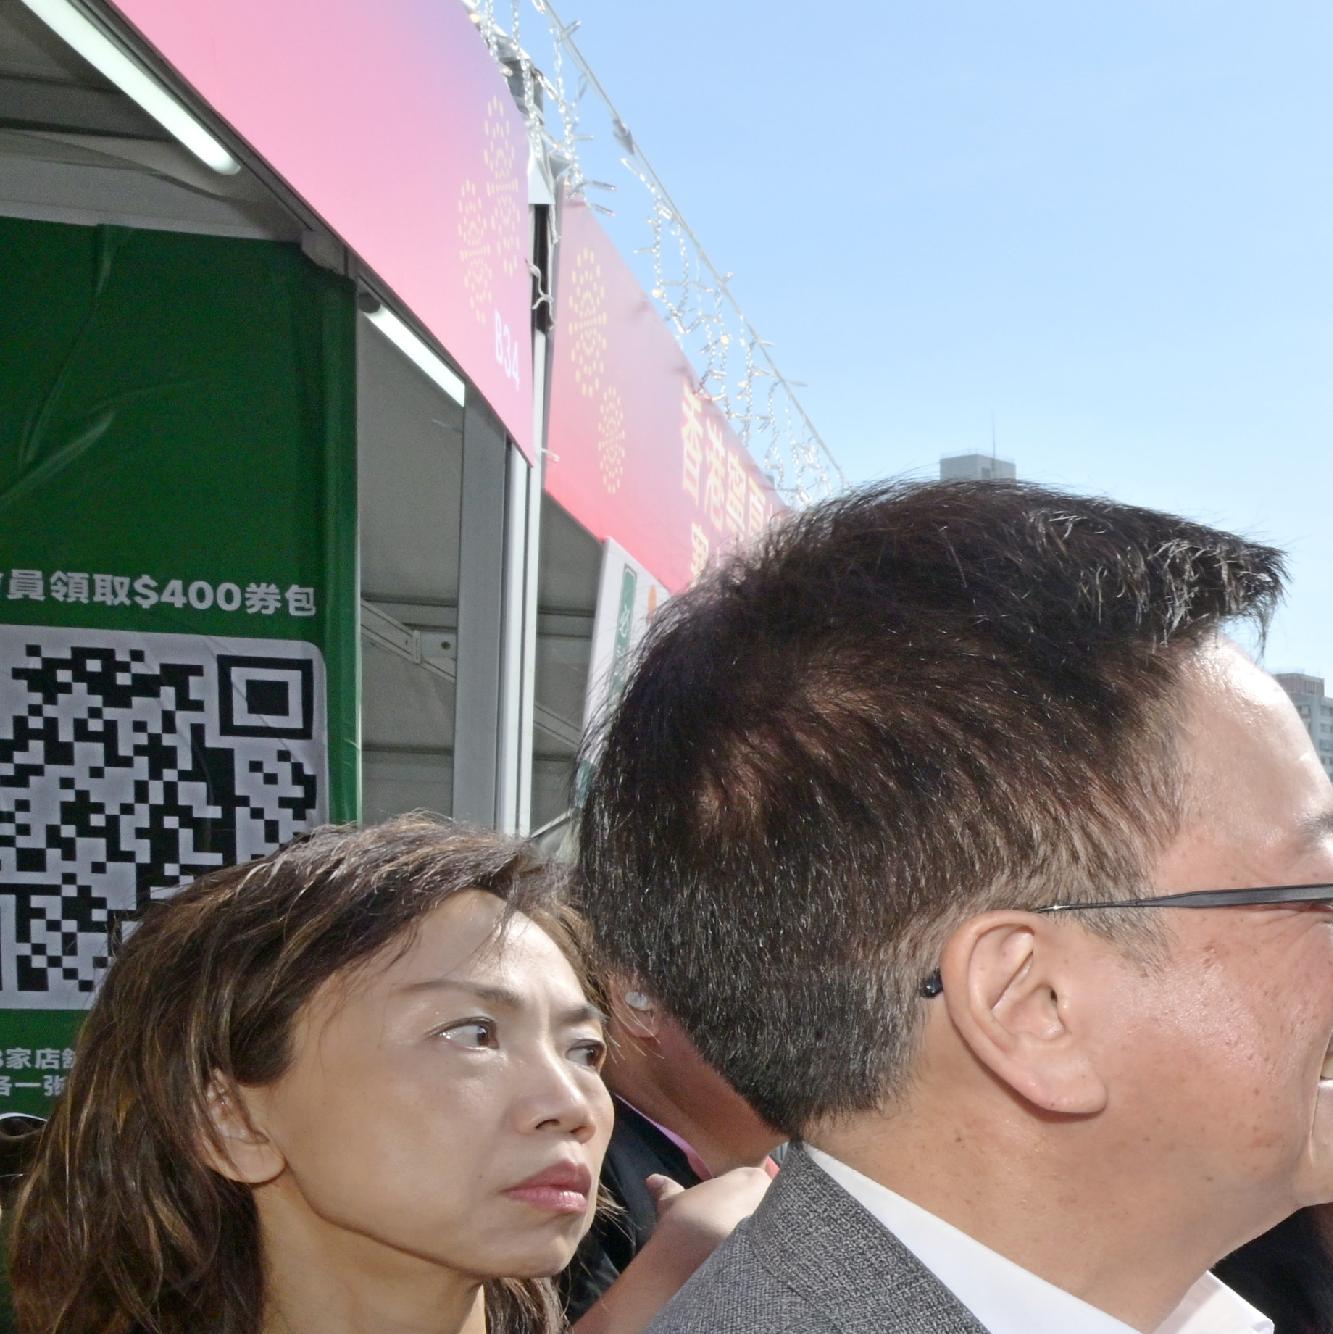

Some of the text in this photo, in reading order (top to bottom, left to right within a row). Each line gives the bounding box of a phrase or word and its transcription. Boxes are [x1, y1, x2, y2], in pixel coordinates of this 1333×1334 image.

[494, 308, 520, 391] B34
[0, 569, 316, 616] 員領取$400券包
